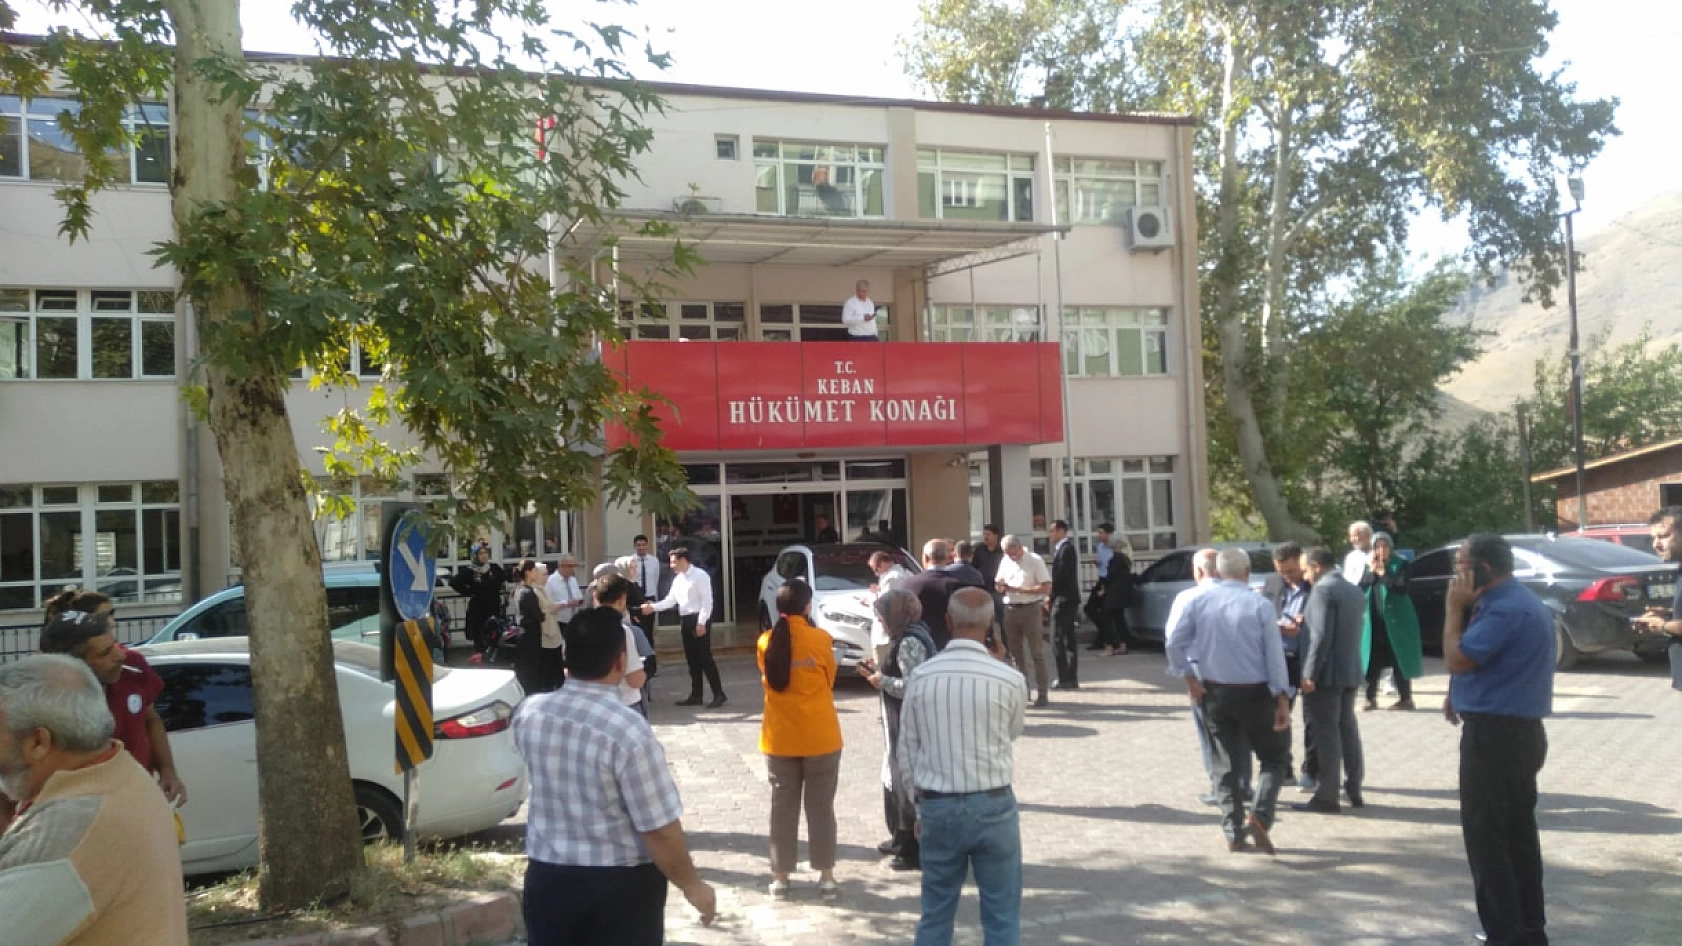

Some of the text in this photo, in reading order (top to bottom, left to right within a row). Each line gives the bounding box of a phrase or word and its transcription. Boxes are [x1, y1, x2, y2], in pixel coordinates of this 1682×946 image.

[834, 360, 857, 375] T.C.
[817, 378, 875, 395] KEBAN
[728, 395, 957, 424] HÜKÜMET KONAĞI
